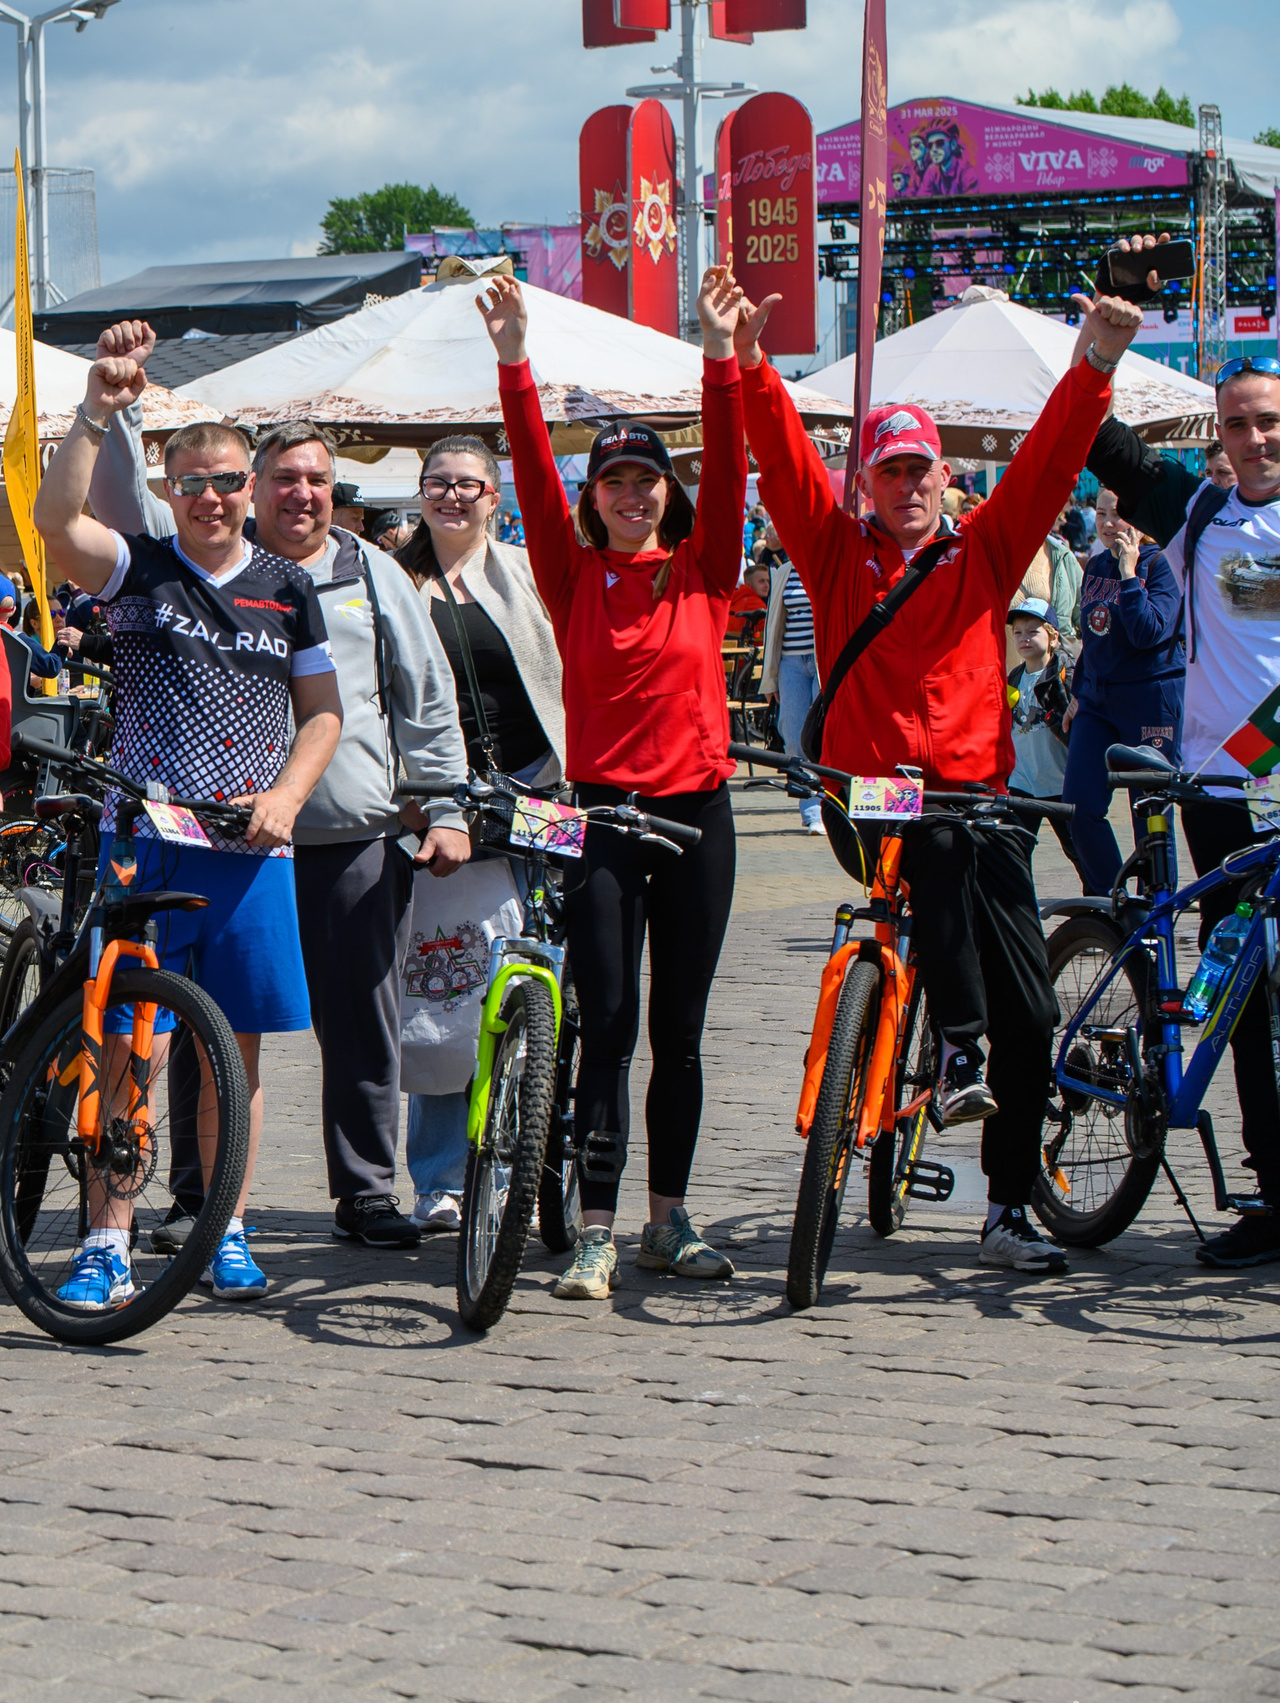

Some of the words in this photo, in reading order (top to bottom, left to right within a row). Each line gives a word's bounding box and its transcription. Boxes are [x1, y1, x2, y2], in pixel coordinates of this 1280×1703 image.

[901, 108, 911, 119] 31
[913, 108, 934, 119] МАЯ
[935, 106, 958, 117] 2025
[733, 145, 812, 192] Победа
[1018, 148, 1085, 172] VIVA
[747, 197, 799, 227] 1945
[746, 233, 800, 264] 2025
[1141, 726, 1175, 742] HARVARD
[853, 804, 882, 812] 11905
[1211, 945, 1266, 1053] AUTHOR
